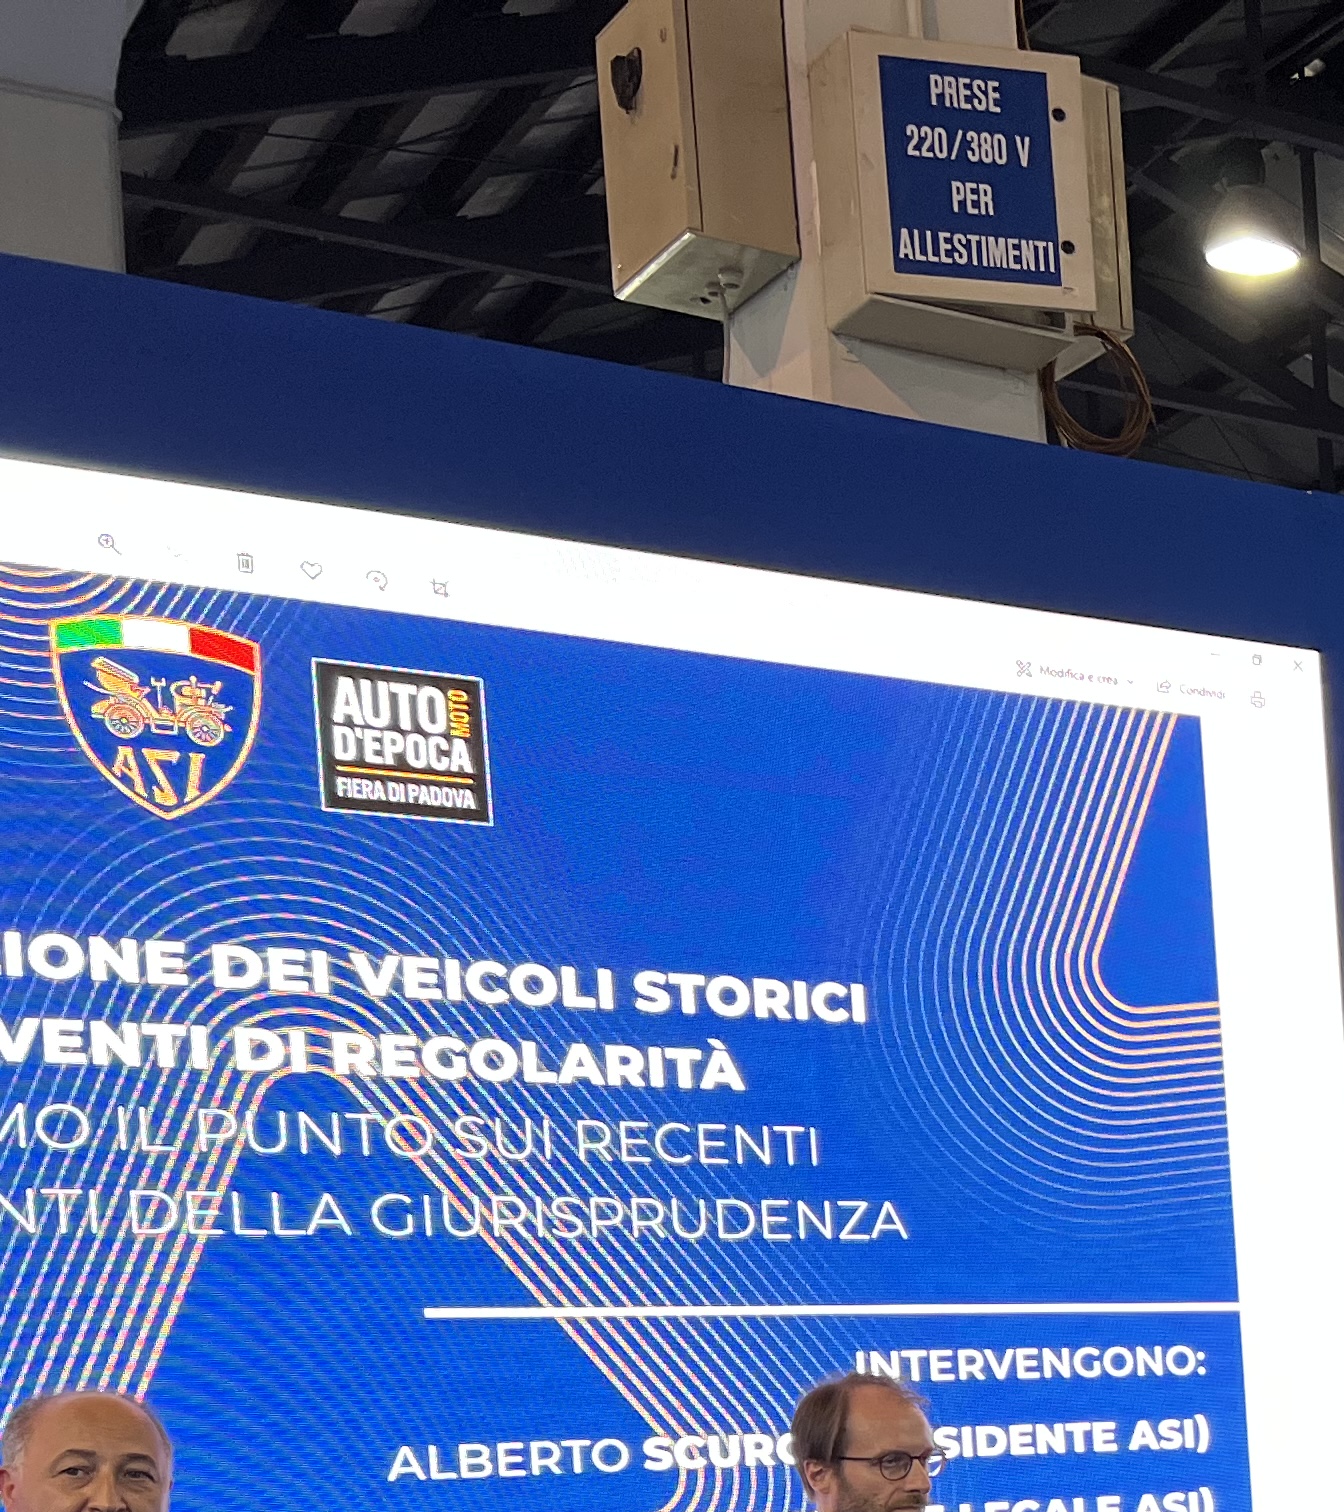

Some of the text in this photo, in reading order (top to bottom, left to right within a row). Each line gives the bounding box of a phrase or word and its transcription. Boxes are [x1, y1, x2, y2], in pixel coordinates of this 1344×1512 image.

[929, 74, 1001, 113] PRESE
[906, 124, 1031, 168] 220/380 V
[951, 180, 994, 216] PER
[899, 227, 1056, 273] ALLESTIMENTI
[333, 676, 447, 735] AUTO
[448, 688, 470, 738] MOTO
[333, 728, 474, 774] D'EPOCA
[335, 775, 477, 811] FIERA DI PADOVA
[212, 943, 331, 994] DEI
[348, 951, 614, 1011] VEICOLI
[633, 970, 867, 1024] STORICI
[233, 1025, 308, 1074] DI
[330, 1031, 746, 1092] REGOLARITÀ
[116, 1105, 176, 1153] IL
[199, 1108, 434, 1158] PUNTO
[454, 1115, 552, 1162] SUI
[576, 1119, 820, 1168] RECENTI
[129, 1188, 353, 1237] DELLA
[370, 1193, 908, 1242] GIURISPRUDENZA
[855, 1344, 1207, 1382] INTERVENGONO:
[387, 1438, 630, 1482] ALBERTO
[1129, 1414, 1211, 1455] ASI)
